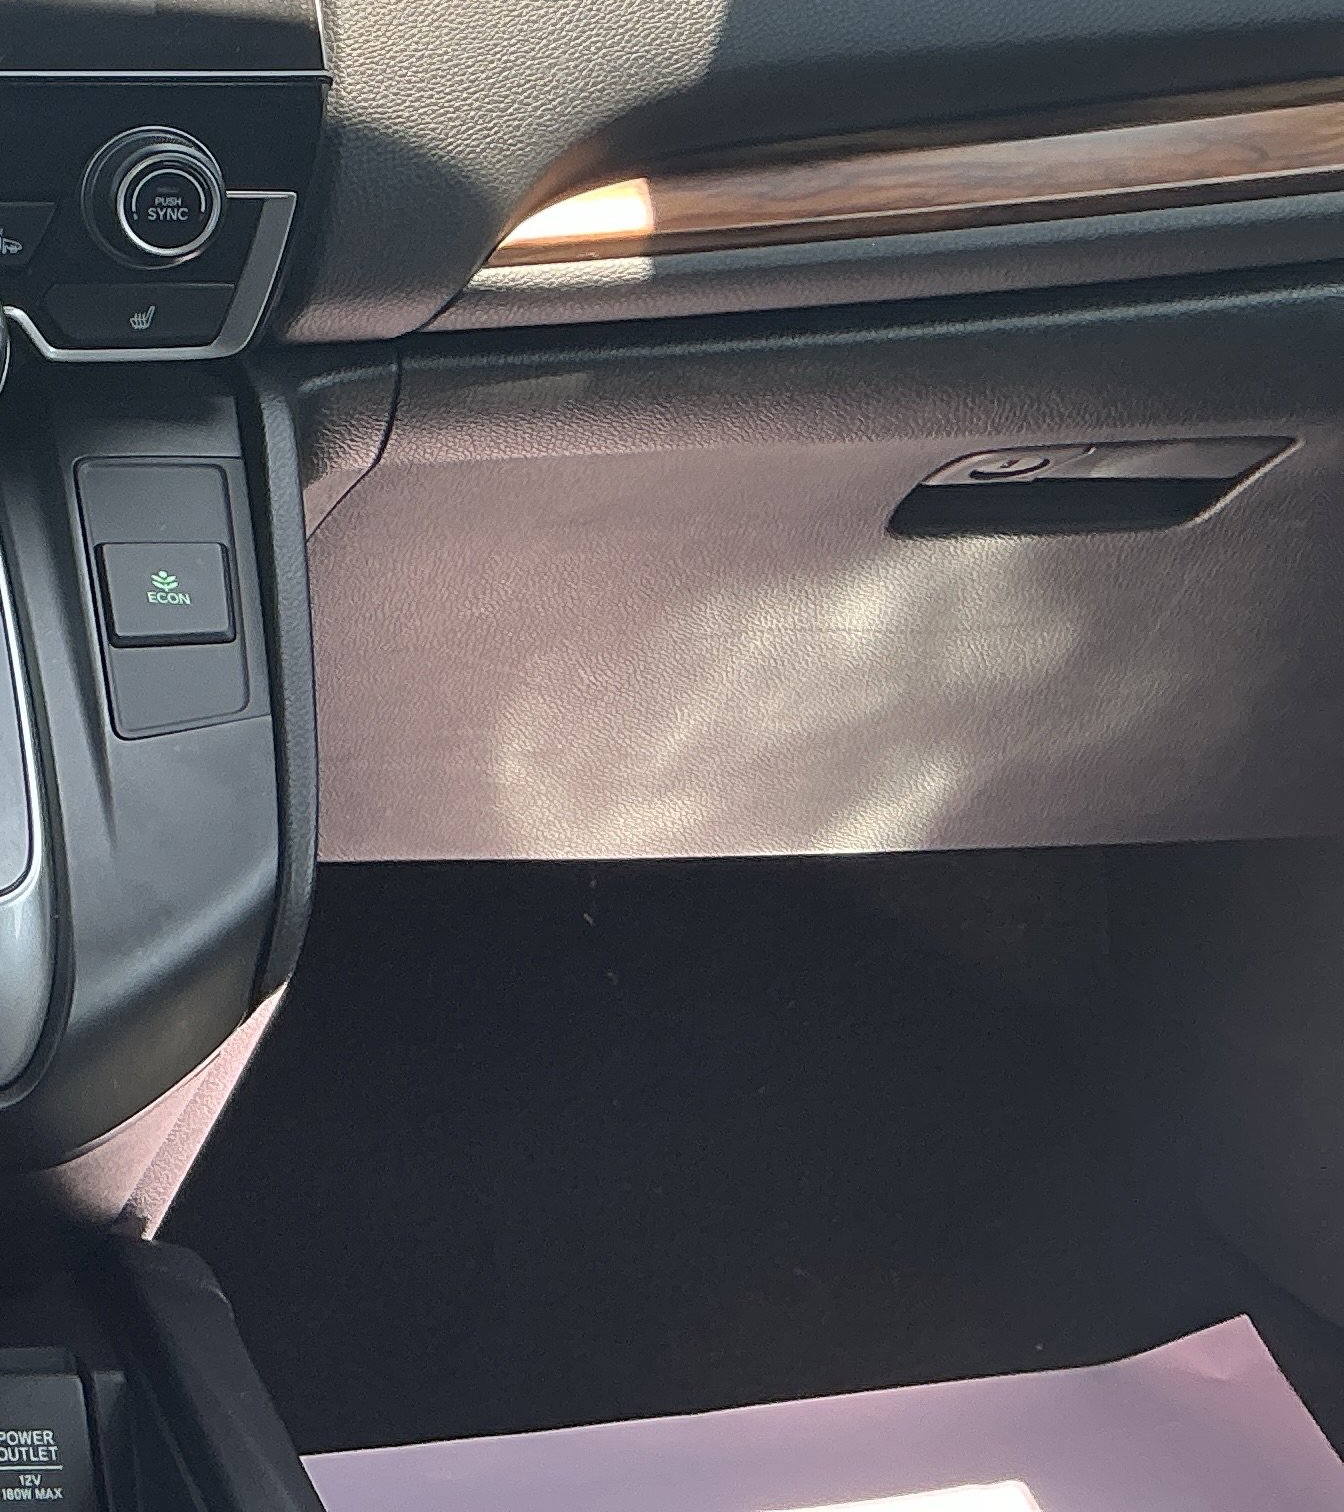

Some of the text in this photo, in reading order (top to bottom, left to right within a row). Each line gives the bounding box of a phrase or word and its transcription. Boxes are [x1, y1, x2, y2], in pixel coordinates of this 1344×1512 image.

[154, 197, 182, 207] PUSH
[147, 207, 189, 222] SYNC
[146, 591, 191, 605] ECON
[18, 1474, 42, 1486] 12V
[34, 1487, 64, 1500] MAX
